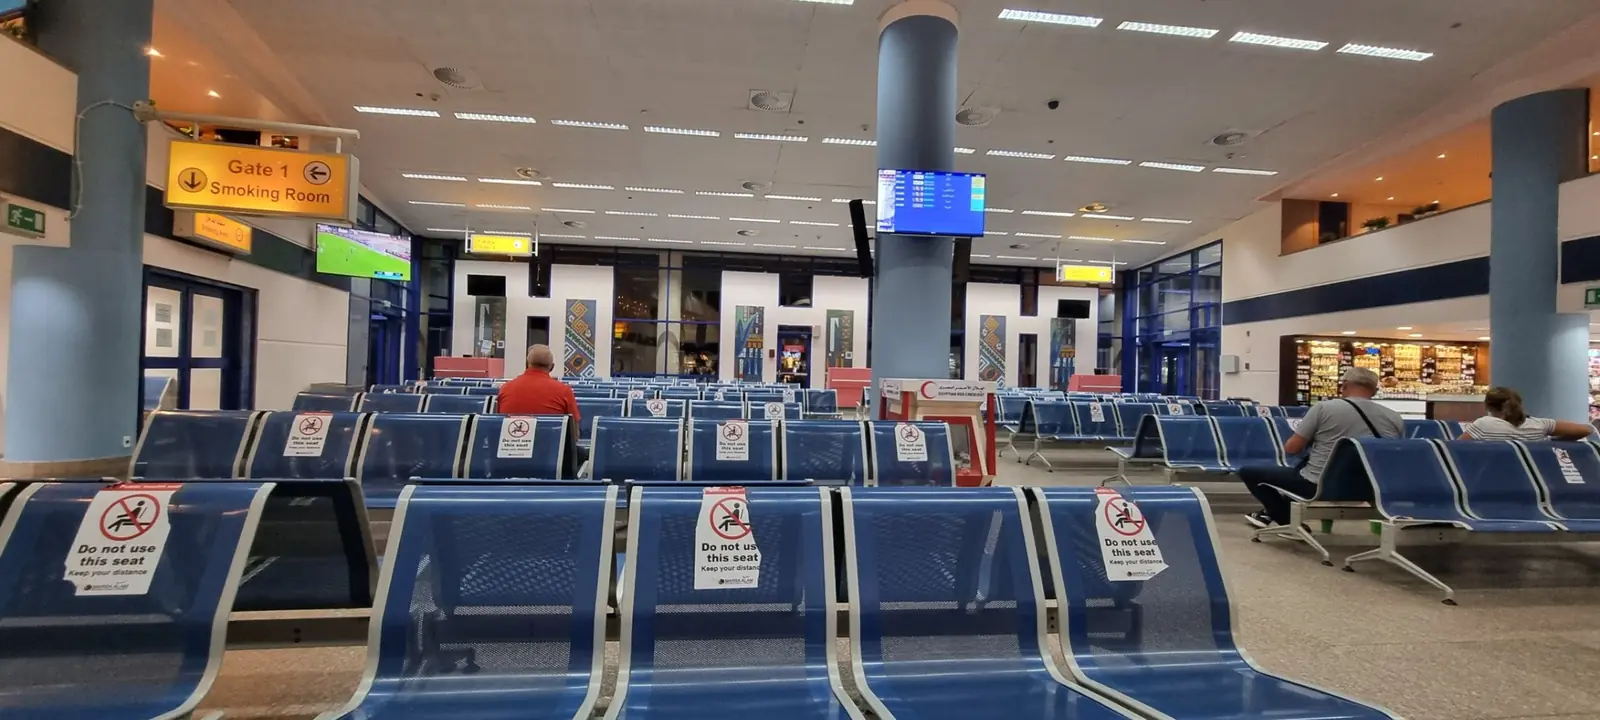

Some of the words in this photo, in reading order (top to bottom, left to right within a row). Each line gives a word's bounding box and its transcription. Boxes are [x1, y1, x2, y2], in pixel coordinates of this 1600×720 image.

[228, 160, 273, 176] Gate
[280, 165, 288, 178] 1
[210, 182, 280, 203] Smoking
[285, 188, 330, 203] Room
[702, 543, 716, 551] Do
[720, 543, 740, 551] not
[1104, 538, 1118, 546] Do
[78, 544, 97, 554] Do
[100, 544, 126, 554] not
[130, 545, 156, 553] use
[80, 557, 108, 566] this
[112, 556, 145, 566] seat
[707, 554, 729, 562] this
[732, 554, 758, 562] seat
